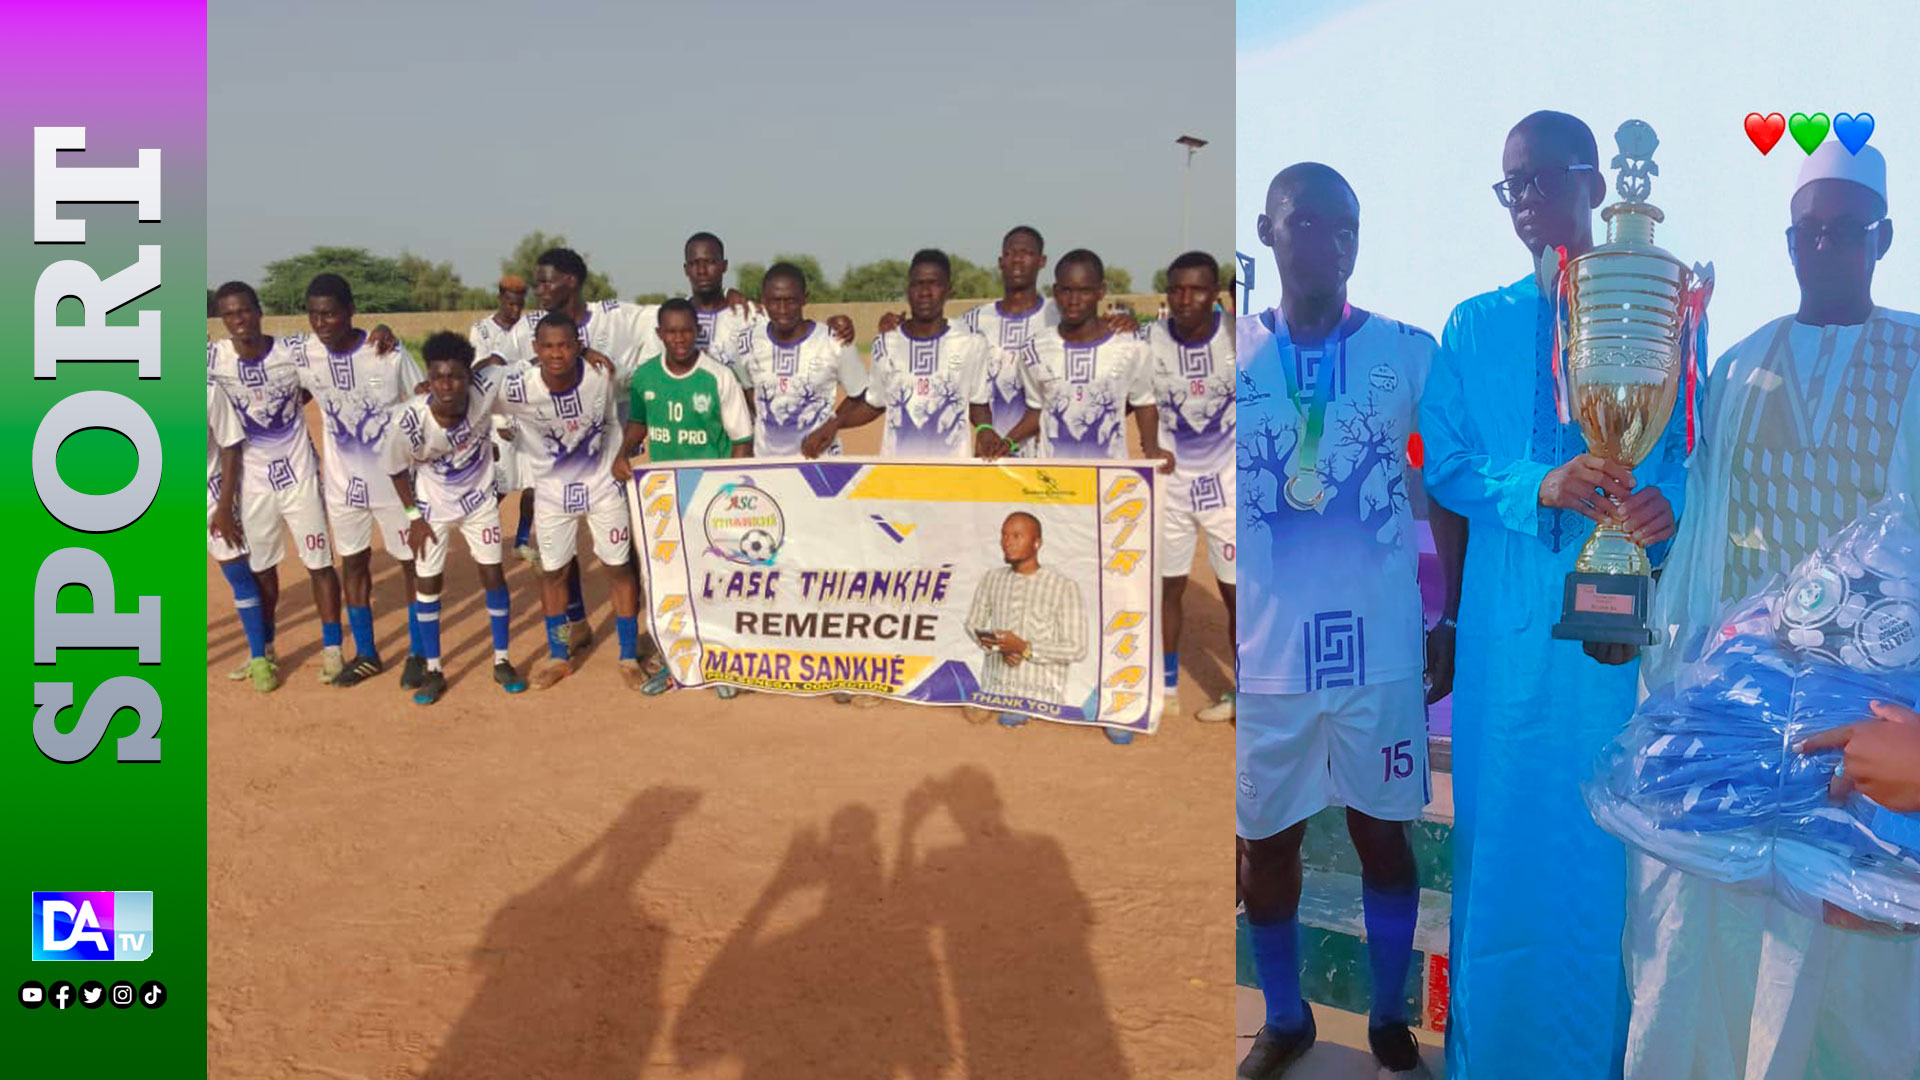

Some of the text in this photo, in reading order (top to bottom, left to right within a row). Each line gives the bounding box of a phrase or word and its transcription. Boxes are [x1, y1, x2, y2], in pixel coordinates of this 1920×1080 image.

[668, 401, 683, 422] 10
[678, 429, 707, 445] PRO
[482, 526, 500, 545] 05
[609, 526, 628, 544] 04
[1103, 475, 1147, 577] FAIR
[305, 533, 326, 550] 06
[800, 564, 952, 602] THIANKHÉ
[735, 611, 938, 641] REMERCIE
[705, 650, 905, 686] MATAR SANKHÉ
[1103, 611, 1147, 715] PLAY
[971, 692, 1061, 716] THANK YOU
[1381, 739, 1414, 783] 15
